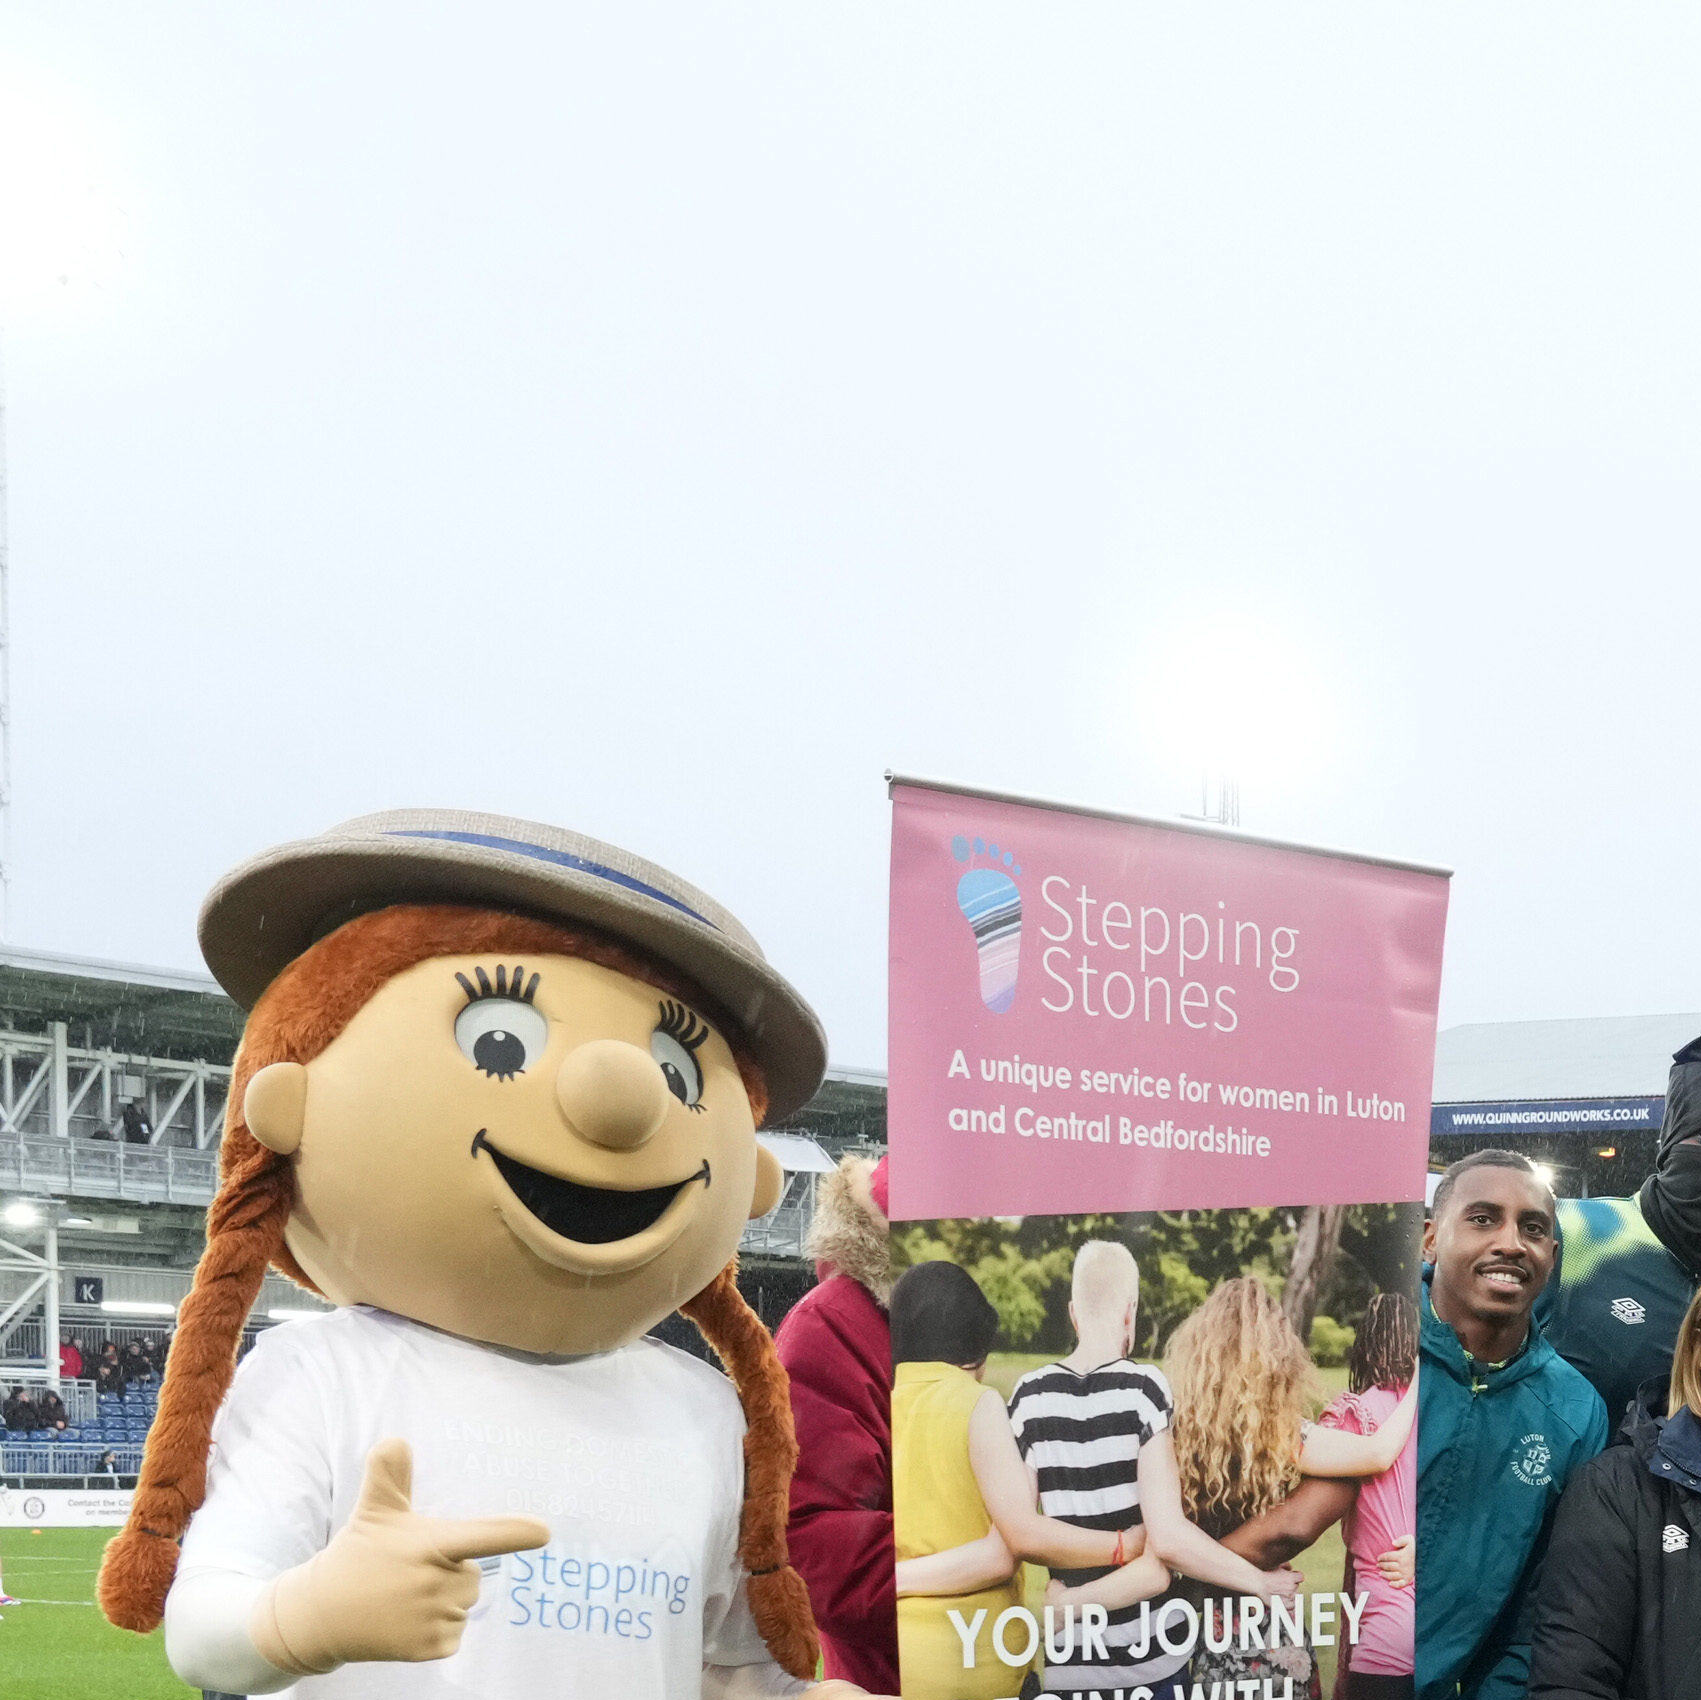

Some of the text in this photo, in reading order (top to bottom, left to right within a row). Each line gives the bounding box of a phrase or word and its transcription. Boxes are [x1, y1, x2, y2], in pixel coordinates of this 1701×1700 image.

[1040, 874, 1300, 993] Stepping
[1040, 946, 1239, 1033] Stones
[947, 1049, 1406, 1123] A unique service for women in Luton
[948, 1104, 1272, 1158] and Central Bedfordshire
[1452, 1108, 1650, 1126] WWW.QUINNGROUNDWORKS.CO.UK
[82, 1284, 95, 1300] K
[1520, 1434, 1545, 1445] LUTON
[1510, 1461, 1552, 1486] FOOTBALL CLUB
[511, 1549, 691, 1615] Stepping
[510, 1586, 653, 1640] Stones
[946, 1591, 1371, 1669] YOUR JOURNEY
